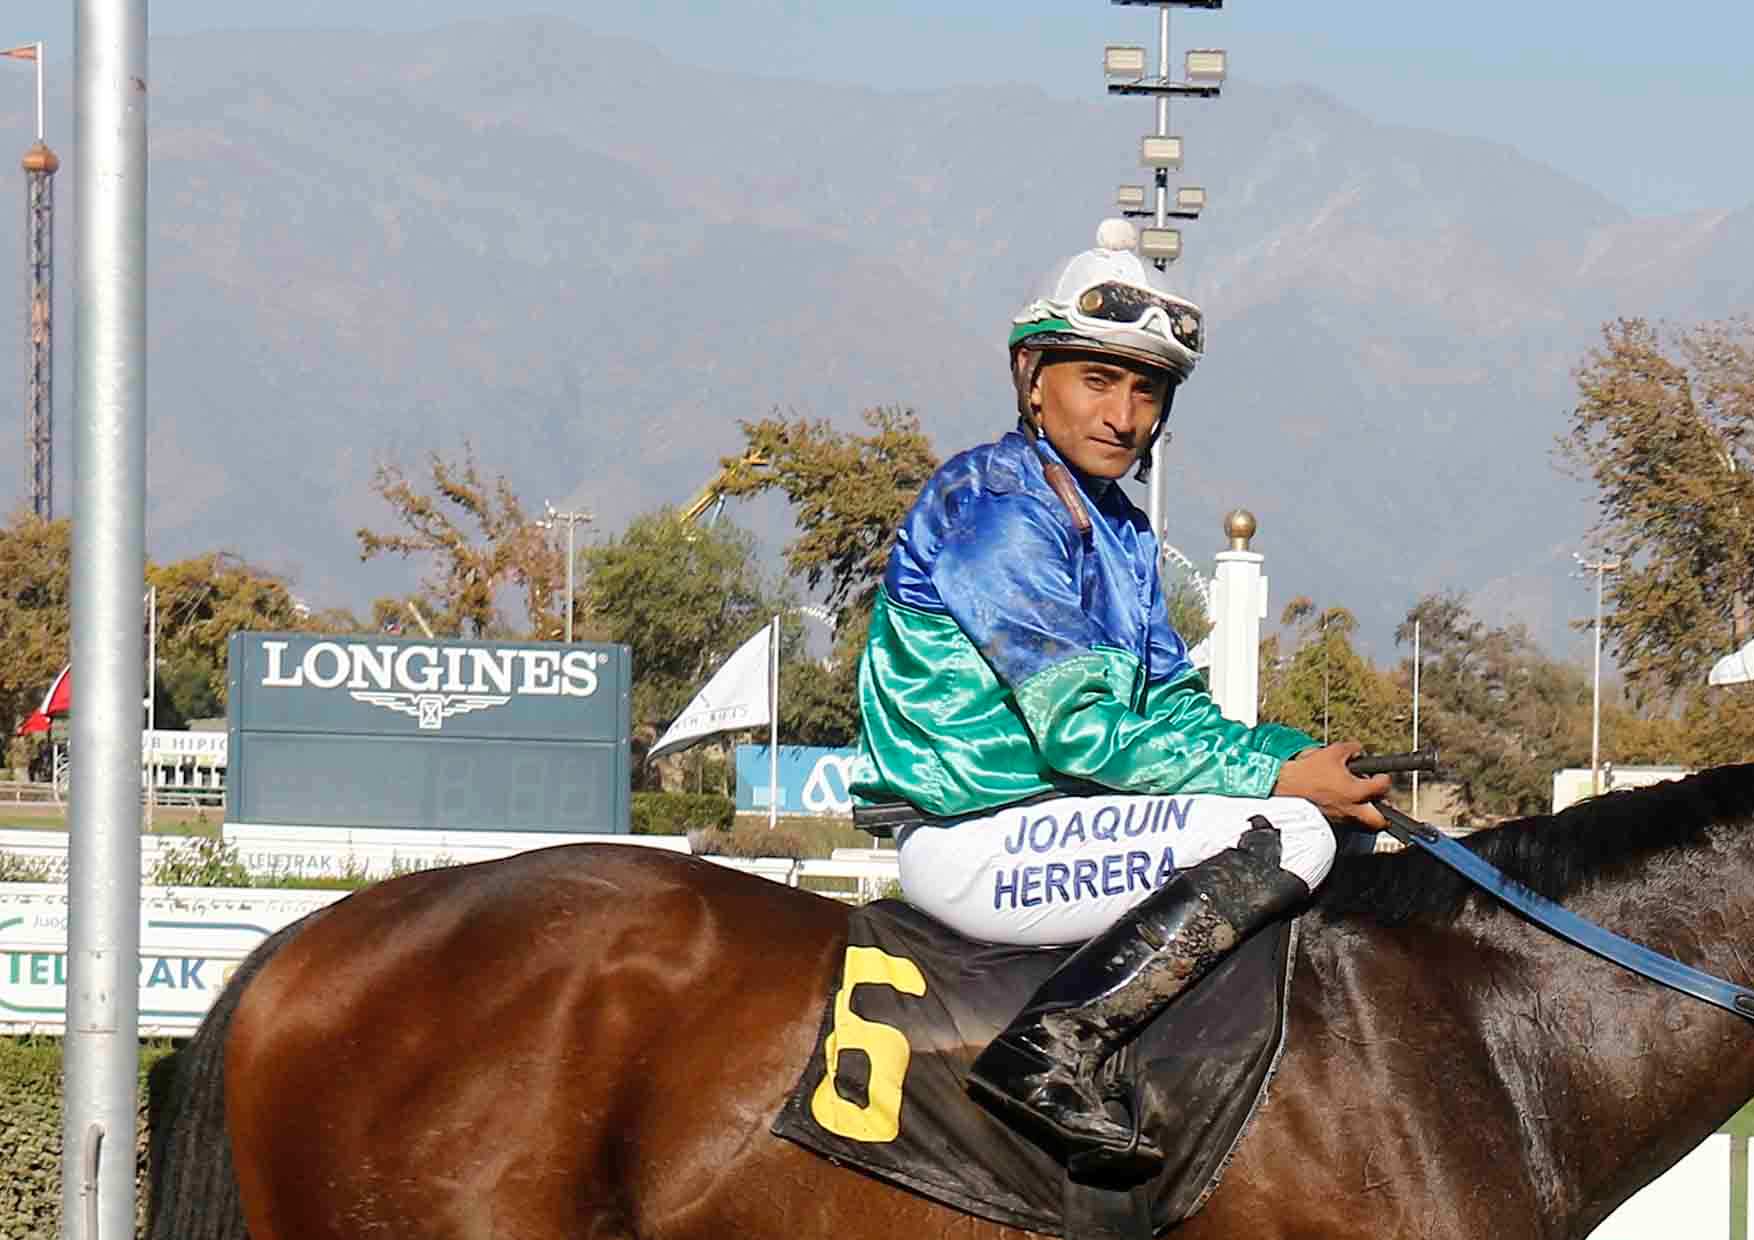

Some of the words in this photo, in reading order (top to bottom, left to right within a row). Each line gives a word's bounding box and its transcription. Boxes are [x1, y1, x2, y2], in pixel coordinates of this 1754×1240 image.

[261, 641, 598, 697] LONGINES
[1004, 798, 1195, 855] JOAQUIN
[993, 846, 1176, 910] HERRERA
[8, 951, 206, 990] TELAK
[811, 945, 927, 1142] 6
